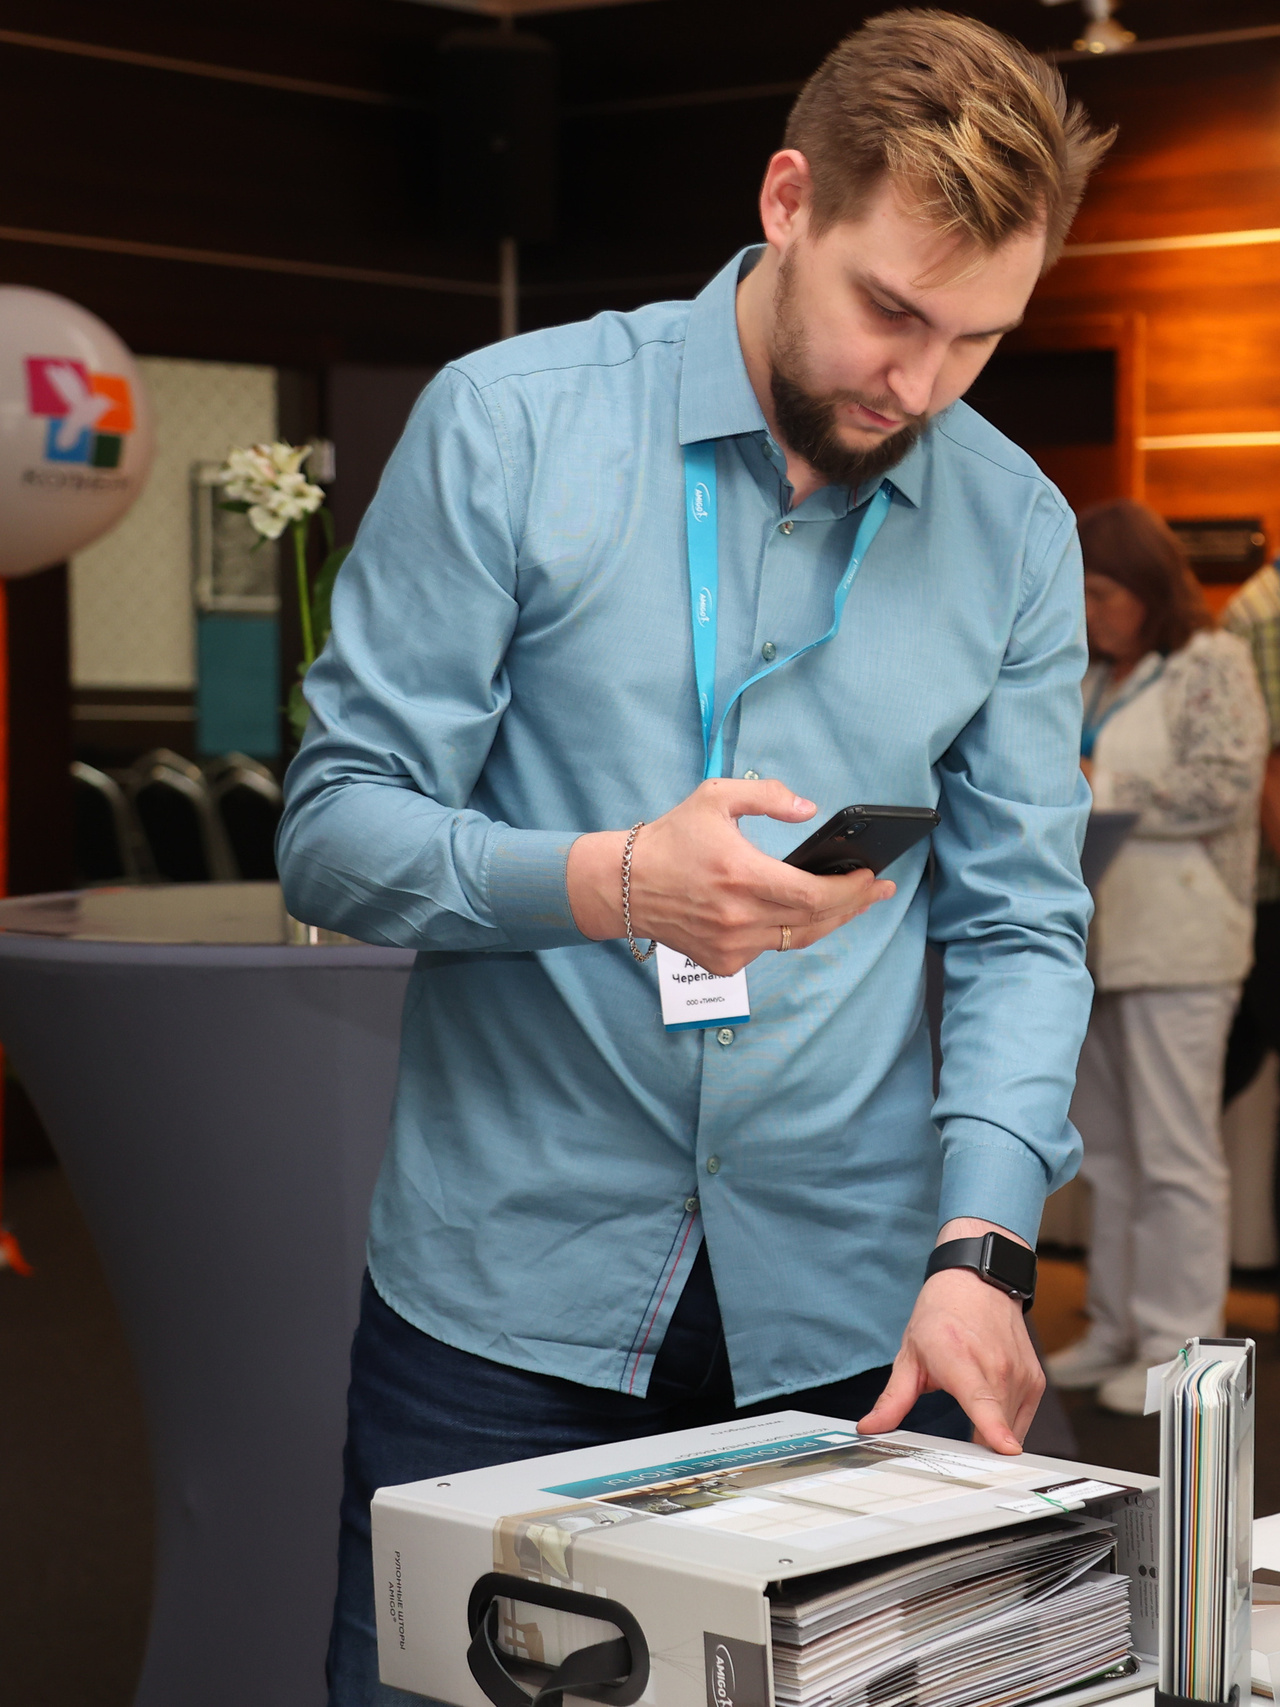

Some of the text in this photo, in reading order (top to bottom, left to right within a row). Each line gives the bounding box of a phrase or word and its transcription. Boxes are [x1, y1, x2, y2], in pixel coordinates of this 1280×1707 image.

[694, 488, 704, 512] AMIGO
[698, 592, 709, 617] AMIGO
[602, 1441, 820, 1487] РУЛОННЫЕ ШТОРЫ
[394, 1550, 406, 1650] РУЛОННЫЕ ШТОРЫ
[716, 1654, 727, 1698] AMIGO
